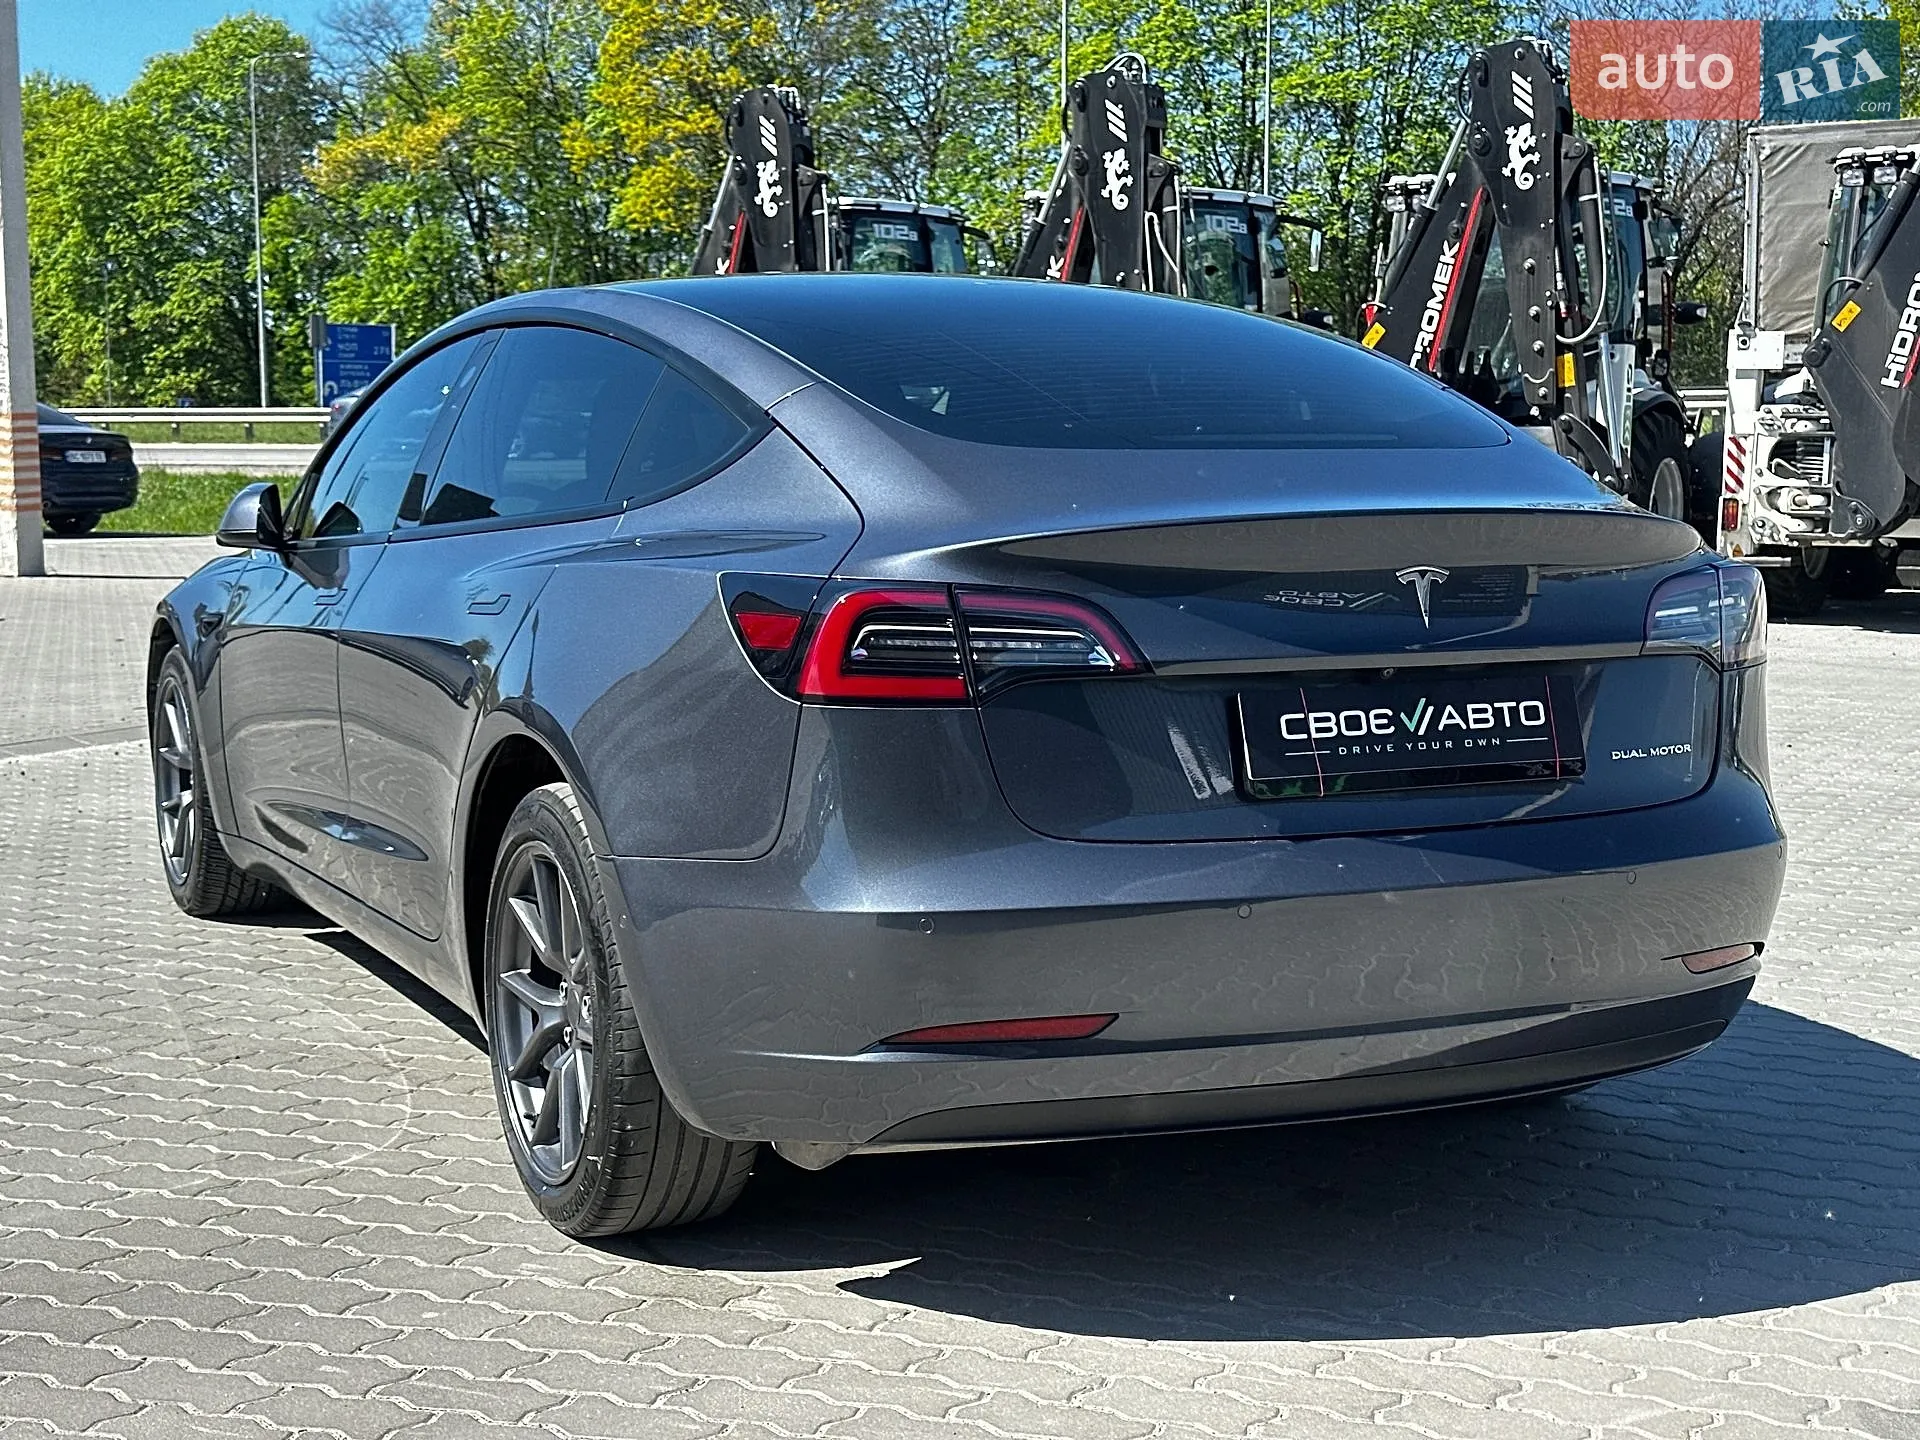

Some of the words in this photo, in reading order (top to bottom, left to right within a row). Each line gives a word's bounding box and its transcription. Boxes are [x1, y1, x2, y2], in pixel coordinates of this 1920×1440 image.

[1046, 255, 1064, 280] K
[1438, 700, 1546, 731] АВТО
[1338, 743, 1395, 755] DRIVE
[1405, 740, 1453, 750] YOUR
[1464, 737, 1500, 748] OWN
[1611, 749, 1647, 760] DUAL
[1650, 743, 1692, 757] MOTOR
